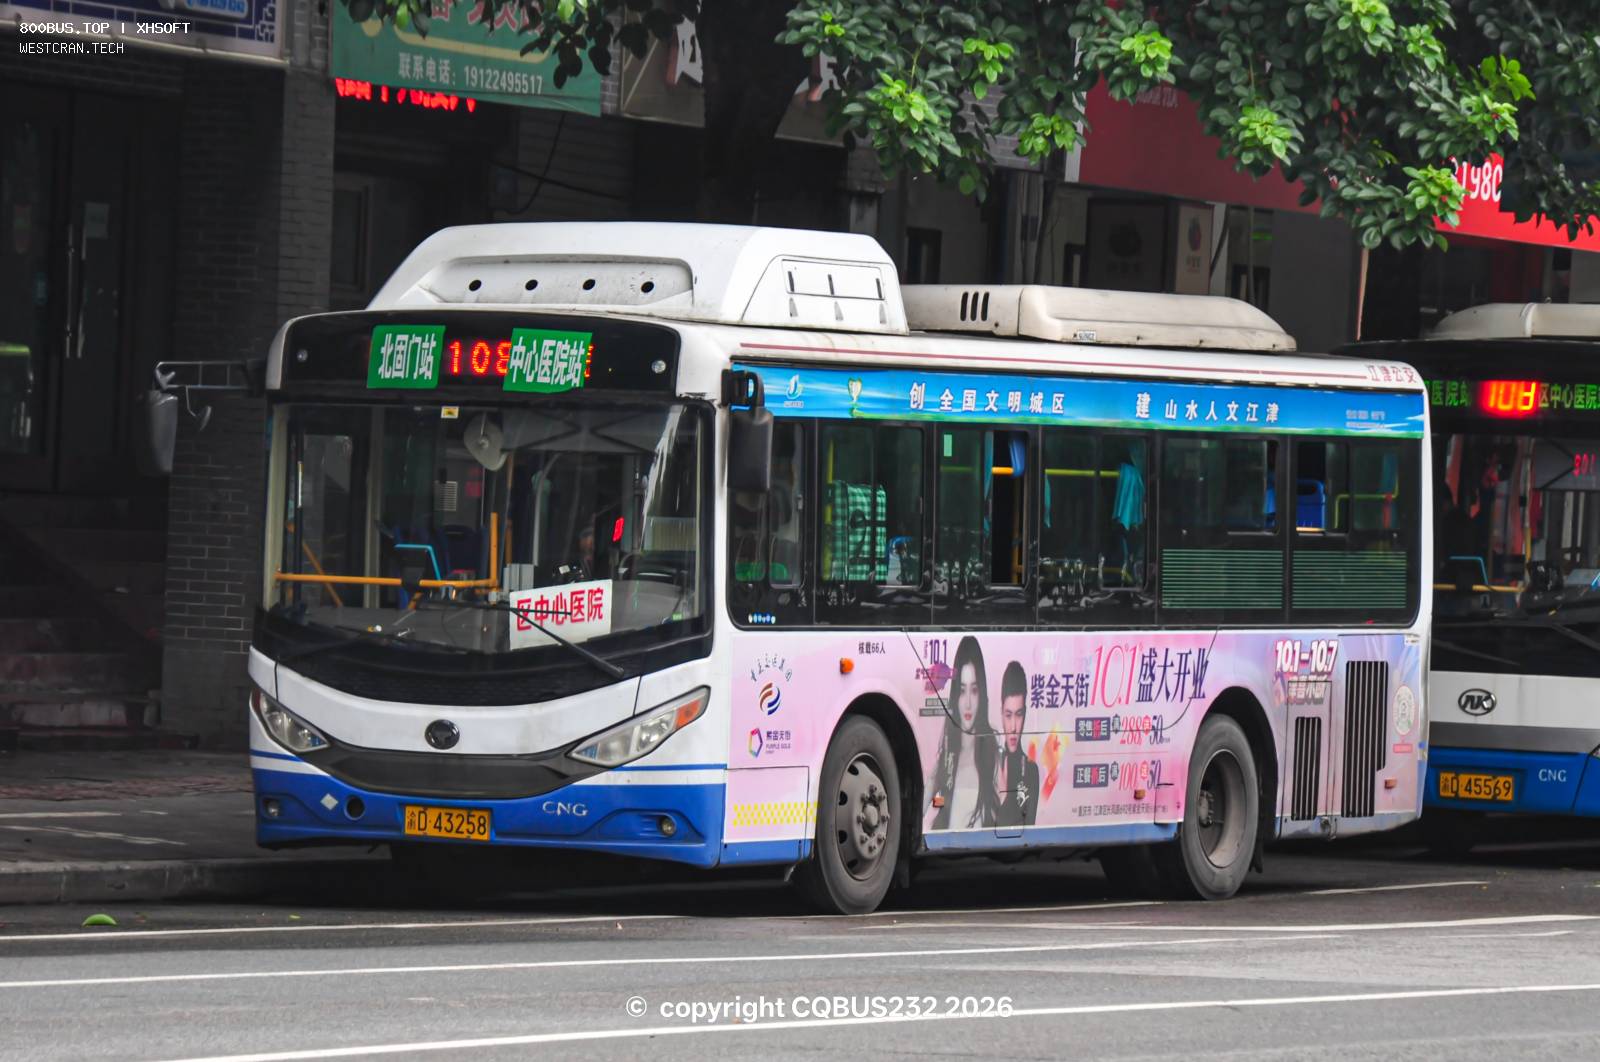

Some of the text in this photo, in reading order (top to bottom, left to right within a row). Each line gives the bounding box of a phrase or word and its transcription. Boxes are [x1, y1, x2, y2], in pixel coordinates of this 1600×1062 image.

[378, 333, 437, 380] 北固门站
[509, 336, 585, 387] 中心医院站
[909, 381, 1280, 423] 创 全国文明城区 建 山水人文江津
[516, 587, 604, 631] 区中心医院
[1276, 640, 1338, 673] 10.1-10.7
[1538, 768, 1567, 782] CNG
[542, 800, 589, 816] CNG
